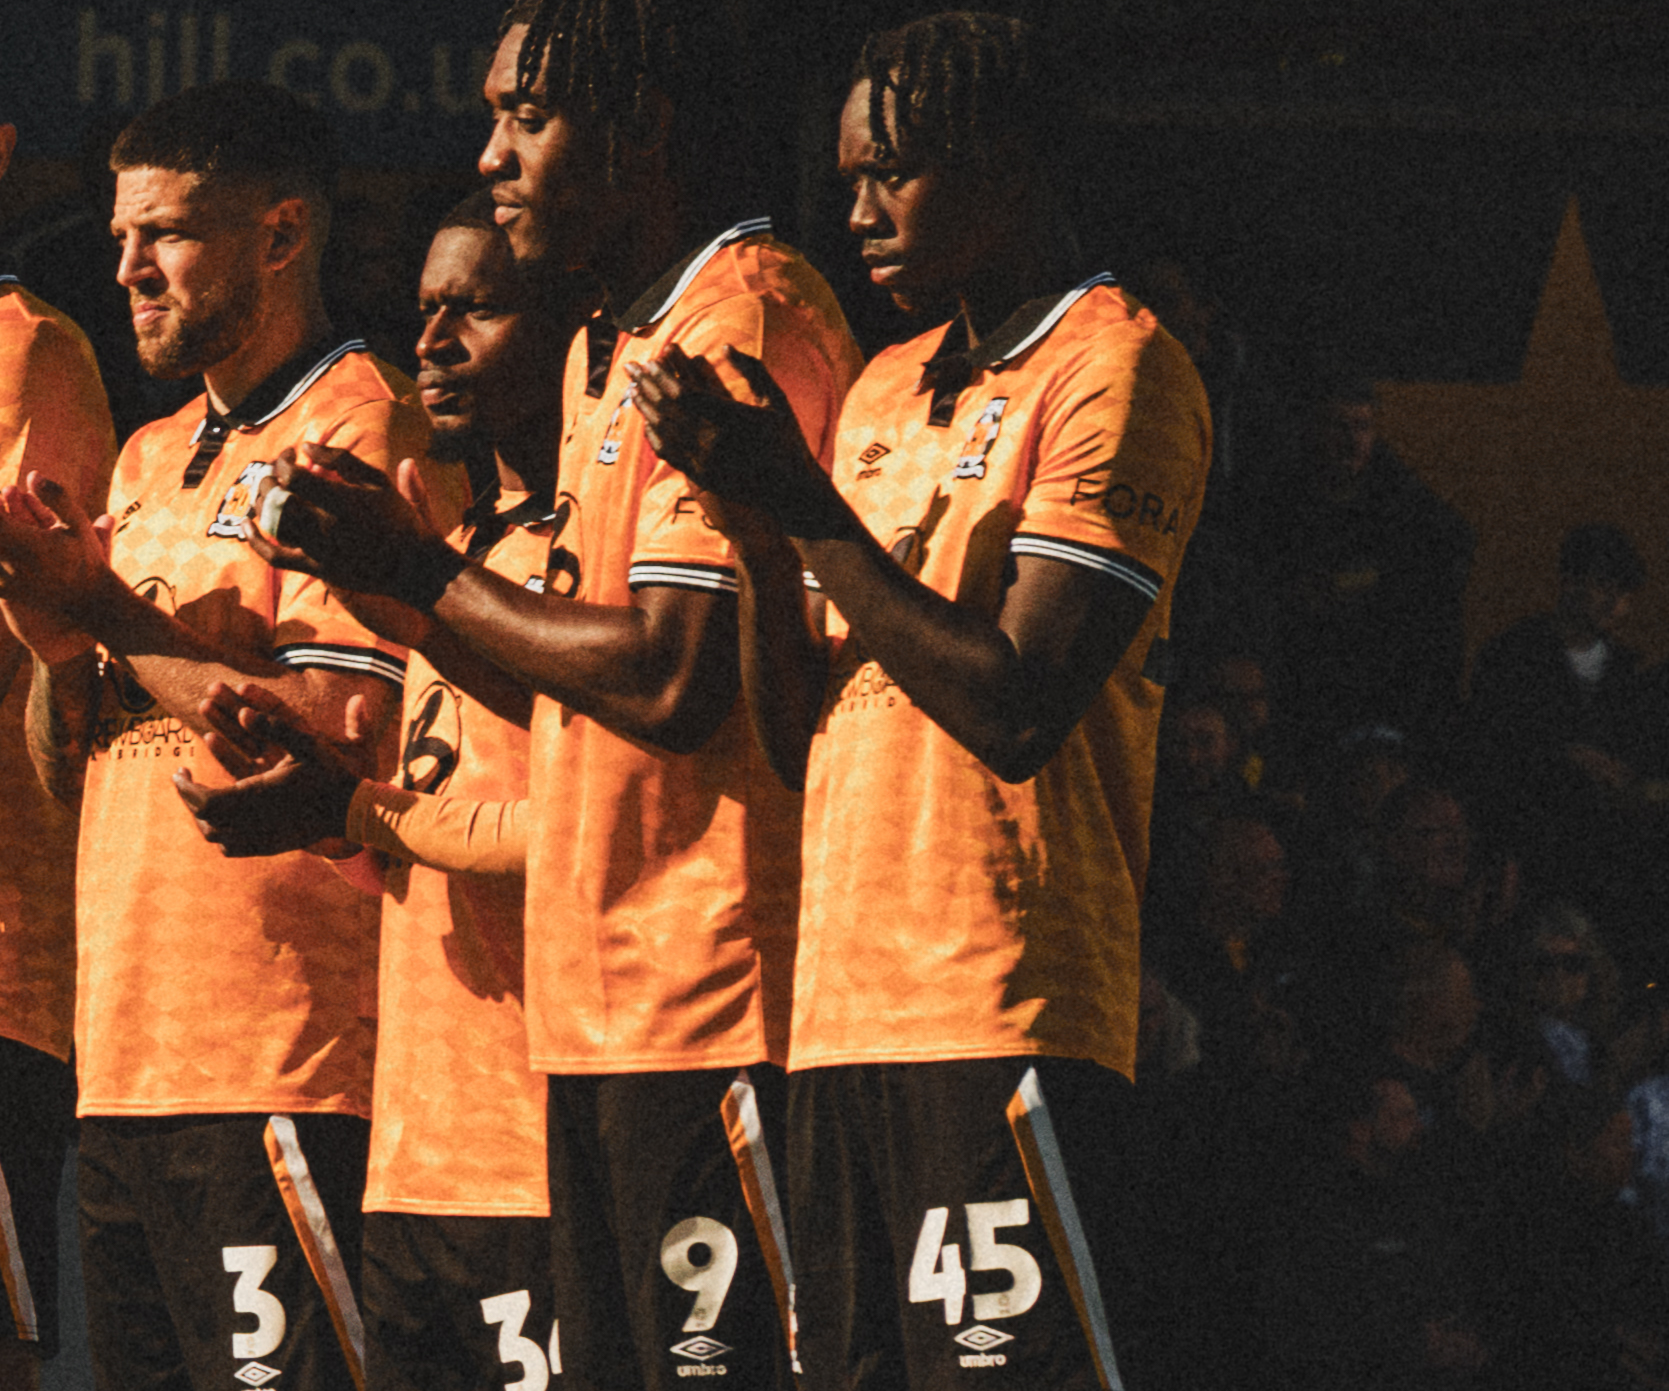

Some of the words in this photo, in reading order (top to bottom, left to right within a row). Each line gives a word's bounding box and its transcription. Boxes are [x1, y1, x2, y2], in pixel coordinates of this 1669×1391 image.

[222, 1245, 286, 1358] 3
[661, 1216, 738, 1332] 9
[909, 1198, 1041, 1325] 45
